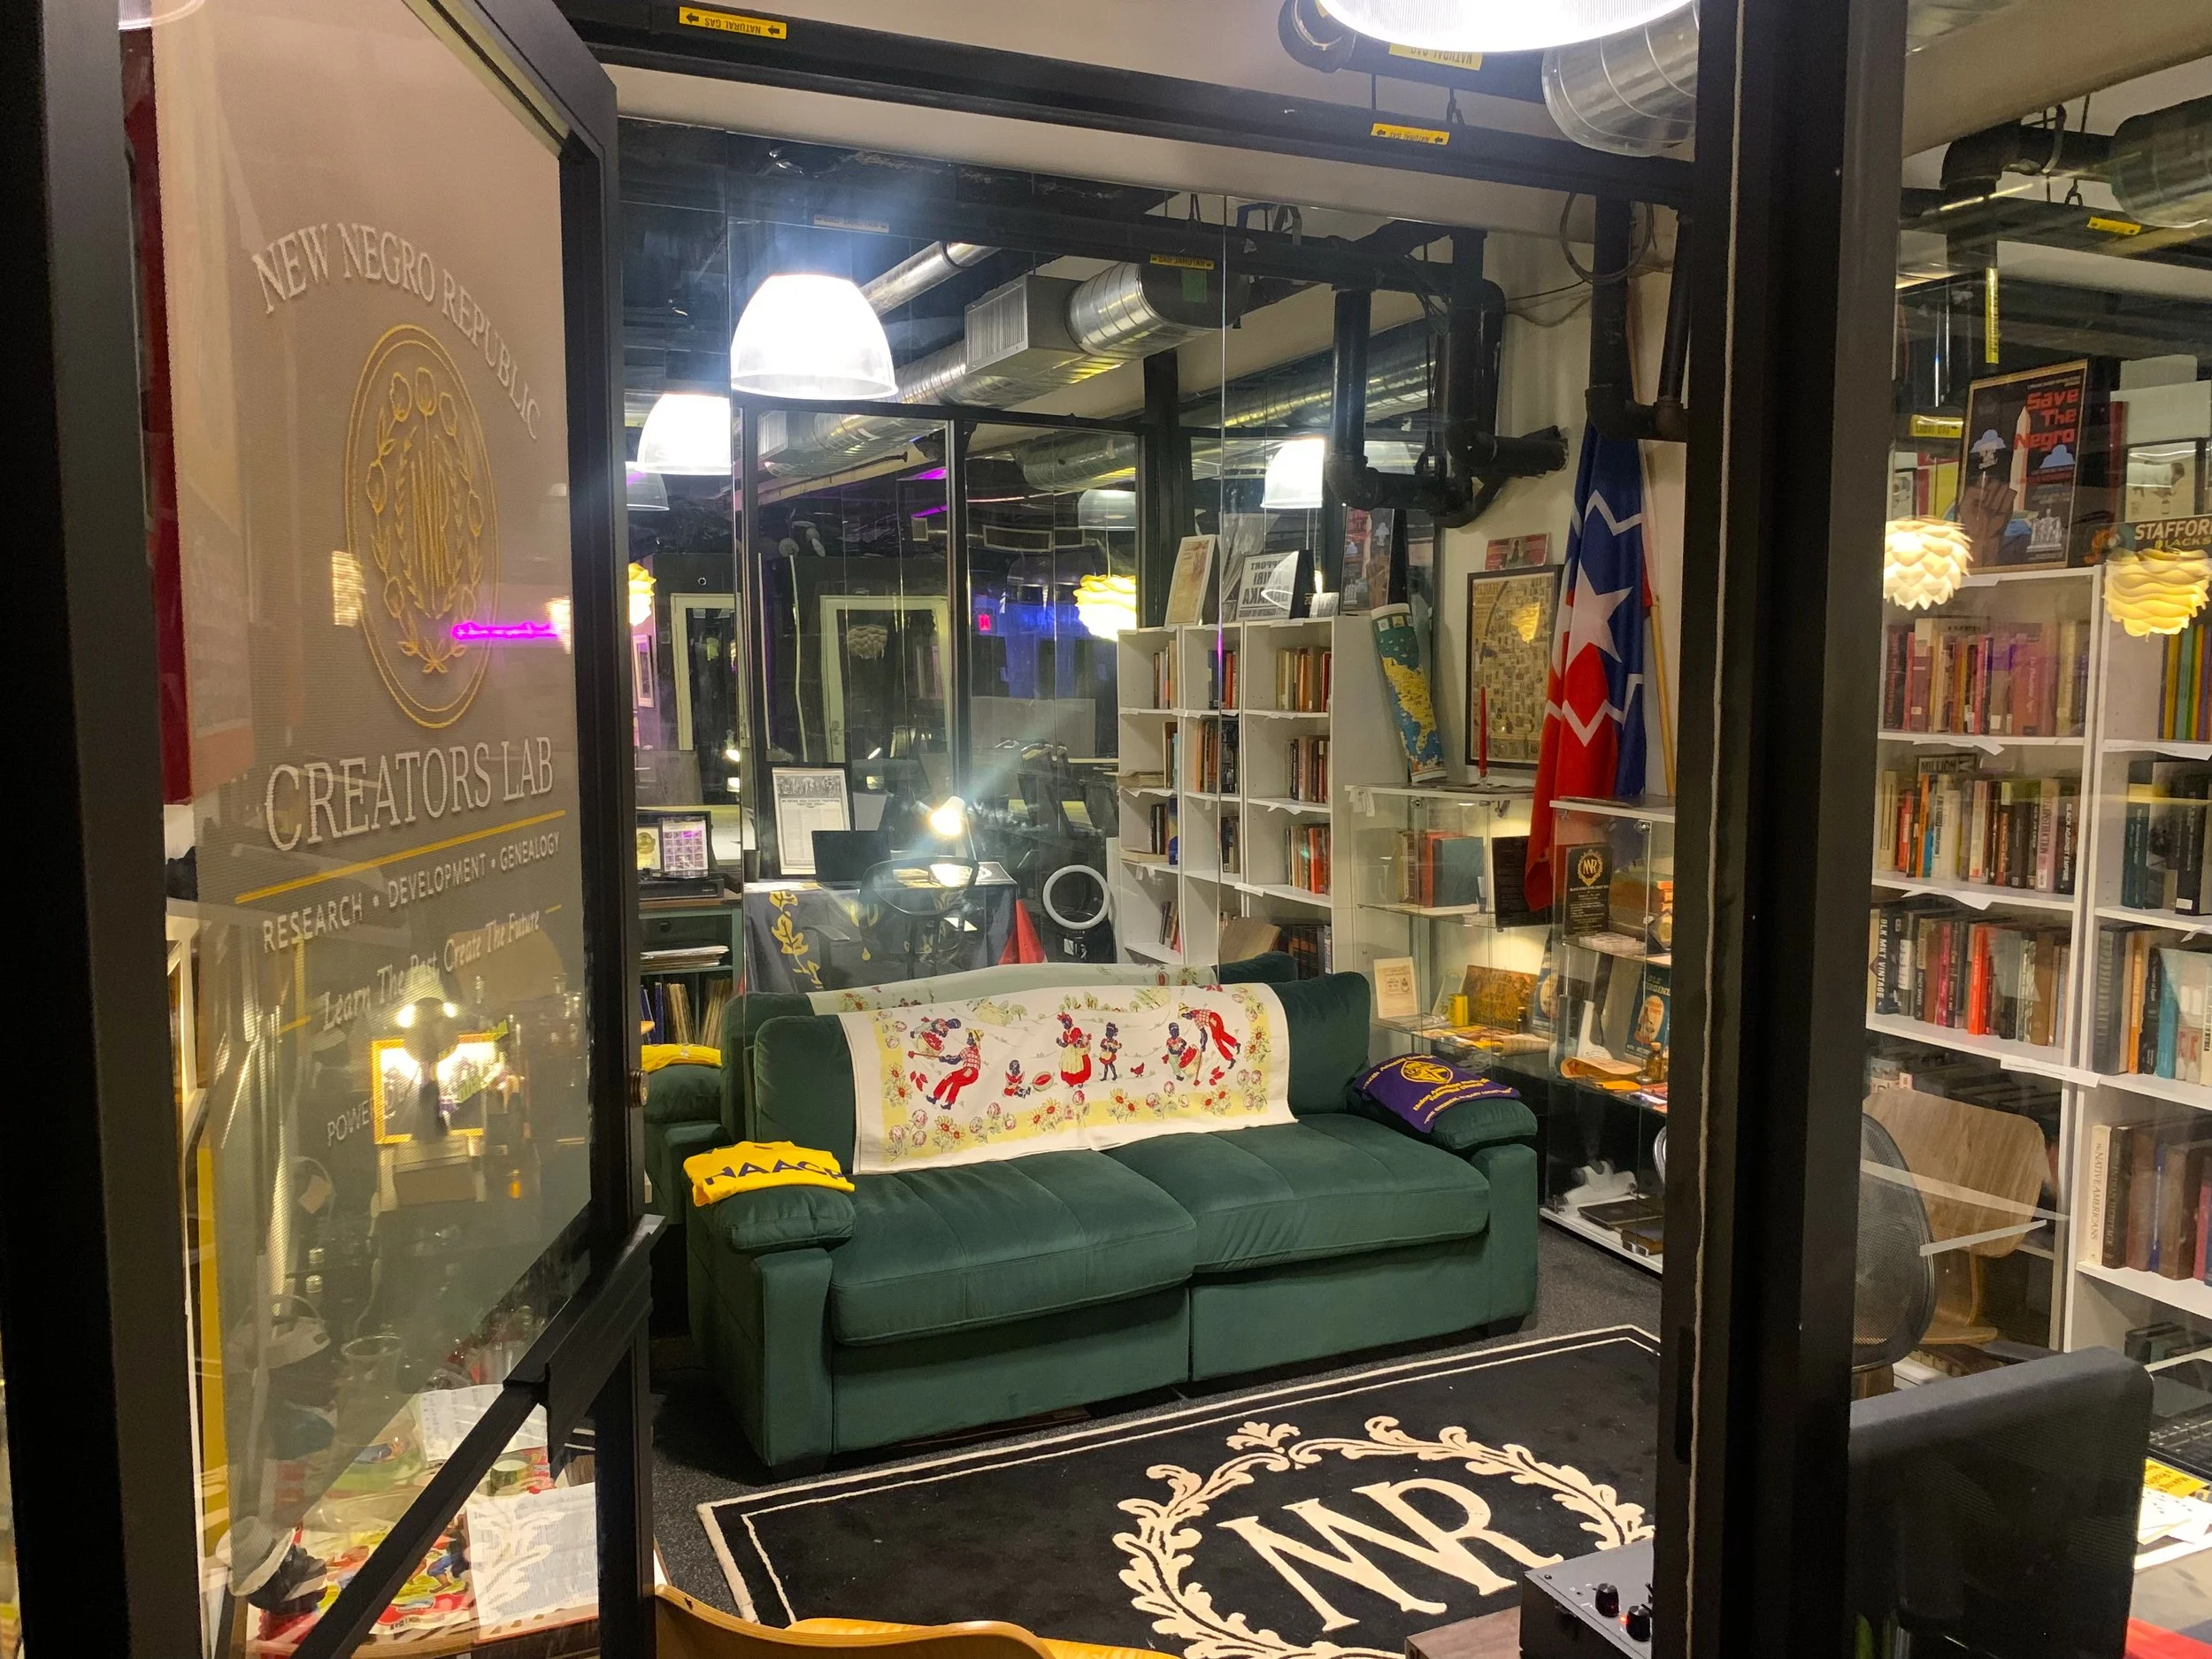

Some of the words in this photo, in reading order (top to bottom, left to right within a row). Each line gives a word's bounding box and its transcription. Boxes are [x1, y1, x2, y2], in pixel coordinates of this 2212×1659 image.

[704, 18, 721, 28] GAS
[726, 20, 761, 35] NATURAL
[251, 223, 332, 314] NEW
[337, 221, 438, 303] NEGRO
[441, 268, 541, 440] REPUBLIC
[2027, 388, 2078, 411] Save
[2041, 408, 2077, 426] The
[2014, 427, 2075, 452] Negro
[2134, 518, 2212, 540] STAFFOR
[265, 742, 492, 851] CREATORS
[502, 736, 553, 803] LAB
[264, 892, 363, 954] RESEARCH
[388, 853, 487, 909] DEVELOPMENT
[499, 831, 560, 872] GENEALOGY
[1879, 918, 1888, 936] BLK
[1878, 938, 1887, 959] MKT
[323, 985, 371, 1032] Learn
[377, 964, 403, 1004] The
[444, 938, 481, 973] Create
[485, 919, 505, 954] The
[508, 910, 540, 943] Future
[1876, 961, 1886, 999] VINTAGE
[2093, 1150, 2103, 1187] NATIVE
[2090, 1186, 2101, 1240] AMERICANS
